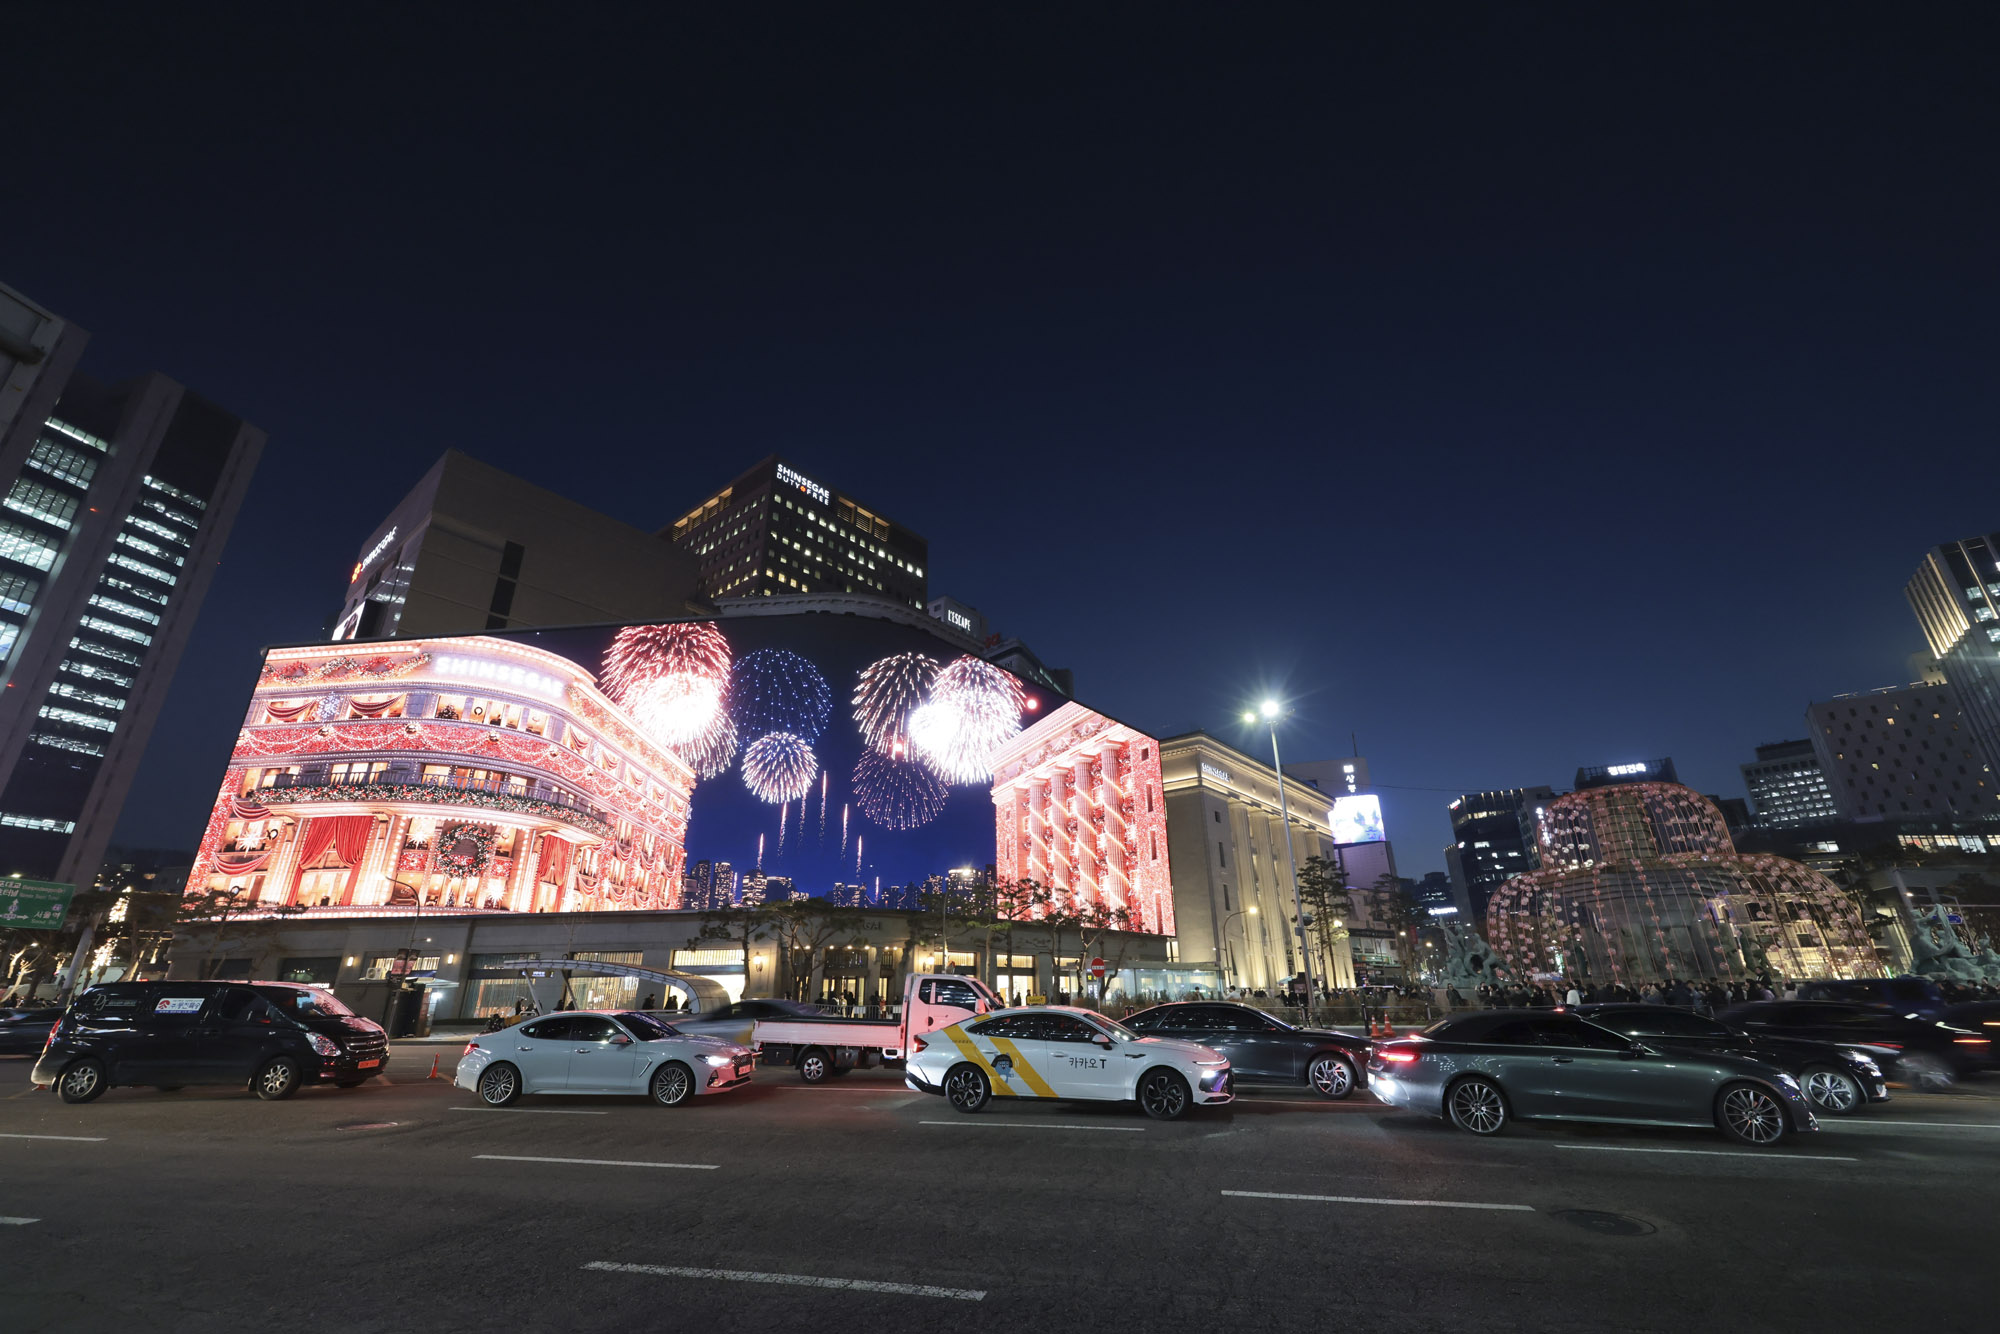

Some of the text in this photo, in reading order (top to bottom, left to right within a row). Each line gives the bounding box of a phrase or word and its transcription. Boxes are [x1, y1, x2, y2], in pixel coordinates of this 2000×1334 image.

[776, 471, 829, 506] DUTY FREE
[777, 463, 830, 499] SHINSEGAE
[947, 609, 971, 632] L'ESCAPE
[435, 656, 563, 699] SHINSEGAE
[33, 911, 61, 920] 서울역
[1069, 1057, 1107, 1069] 카카오 T
